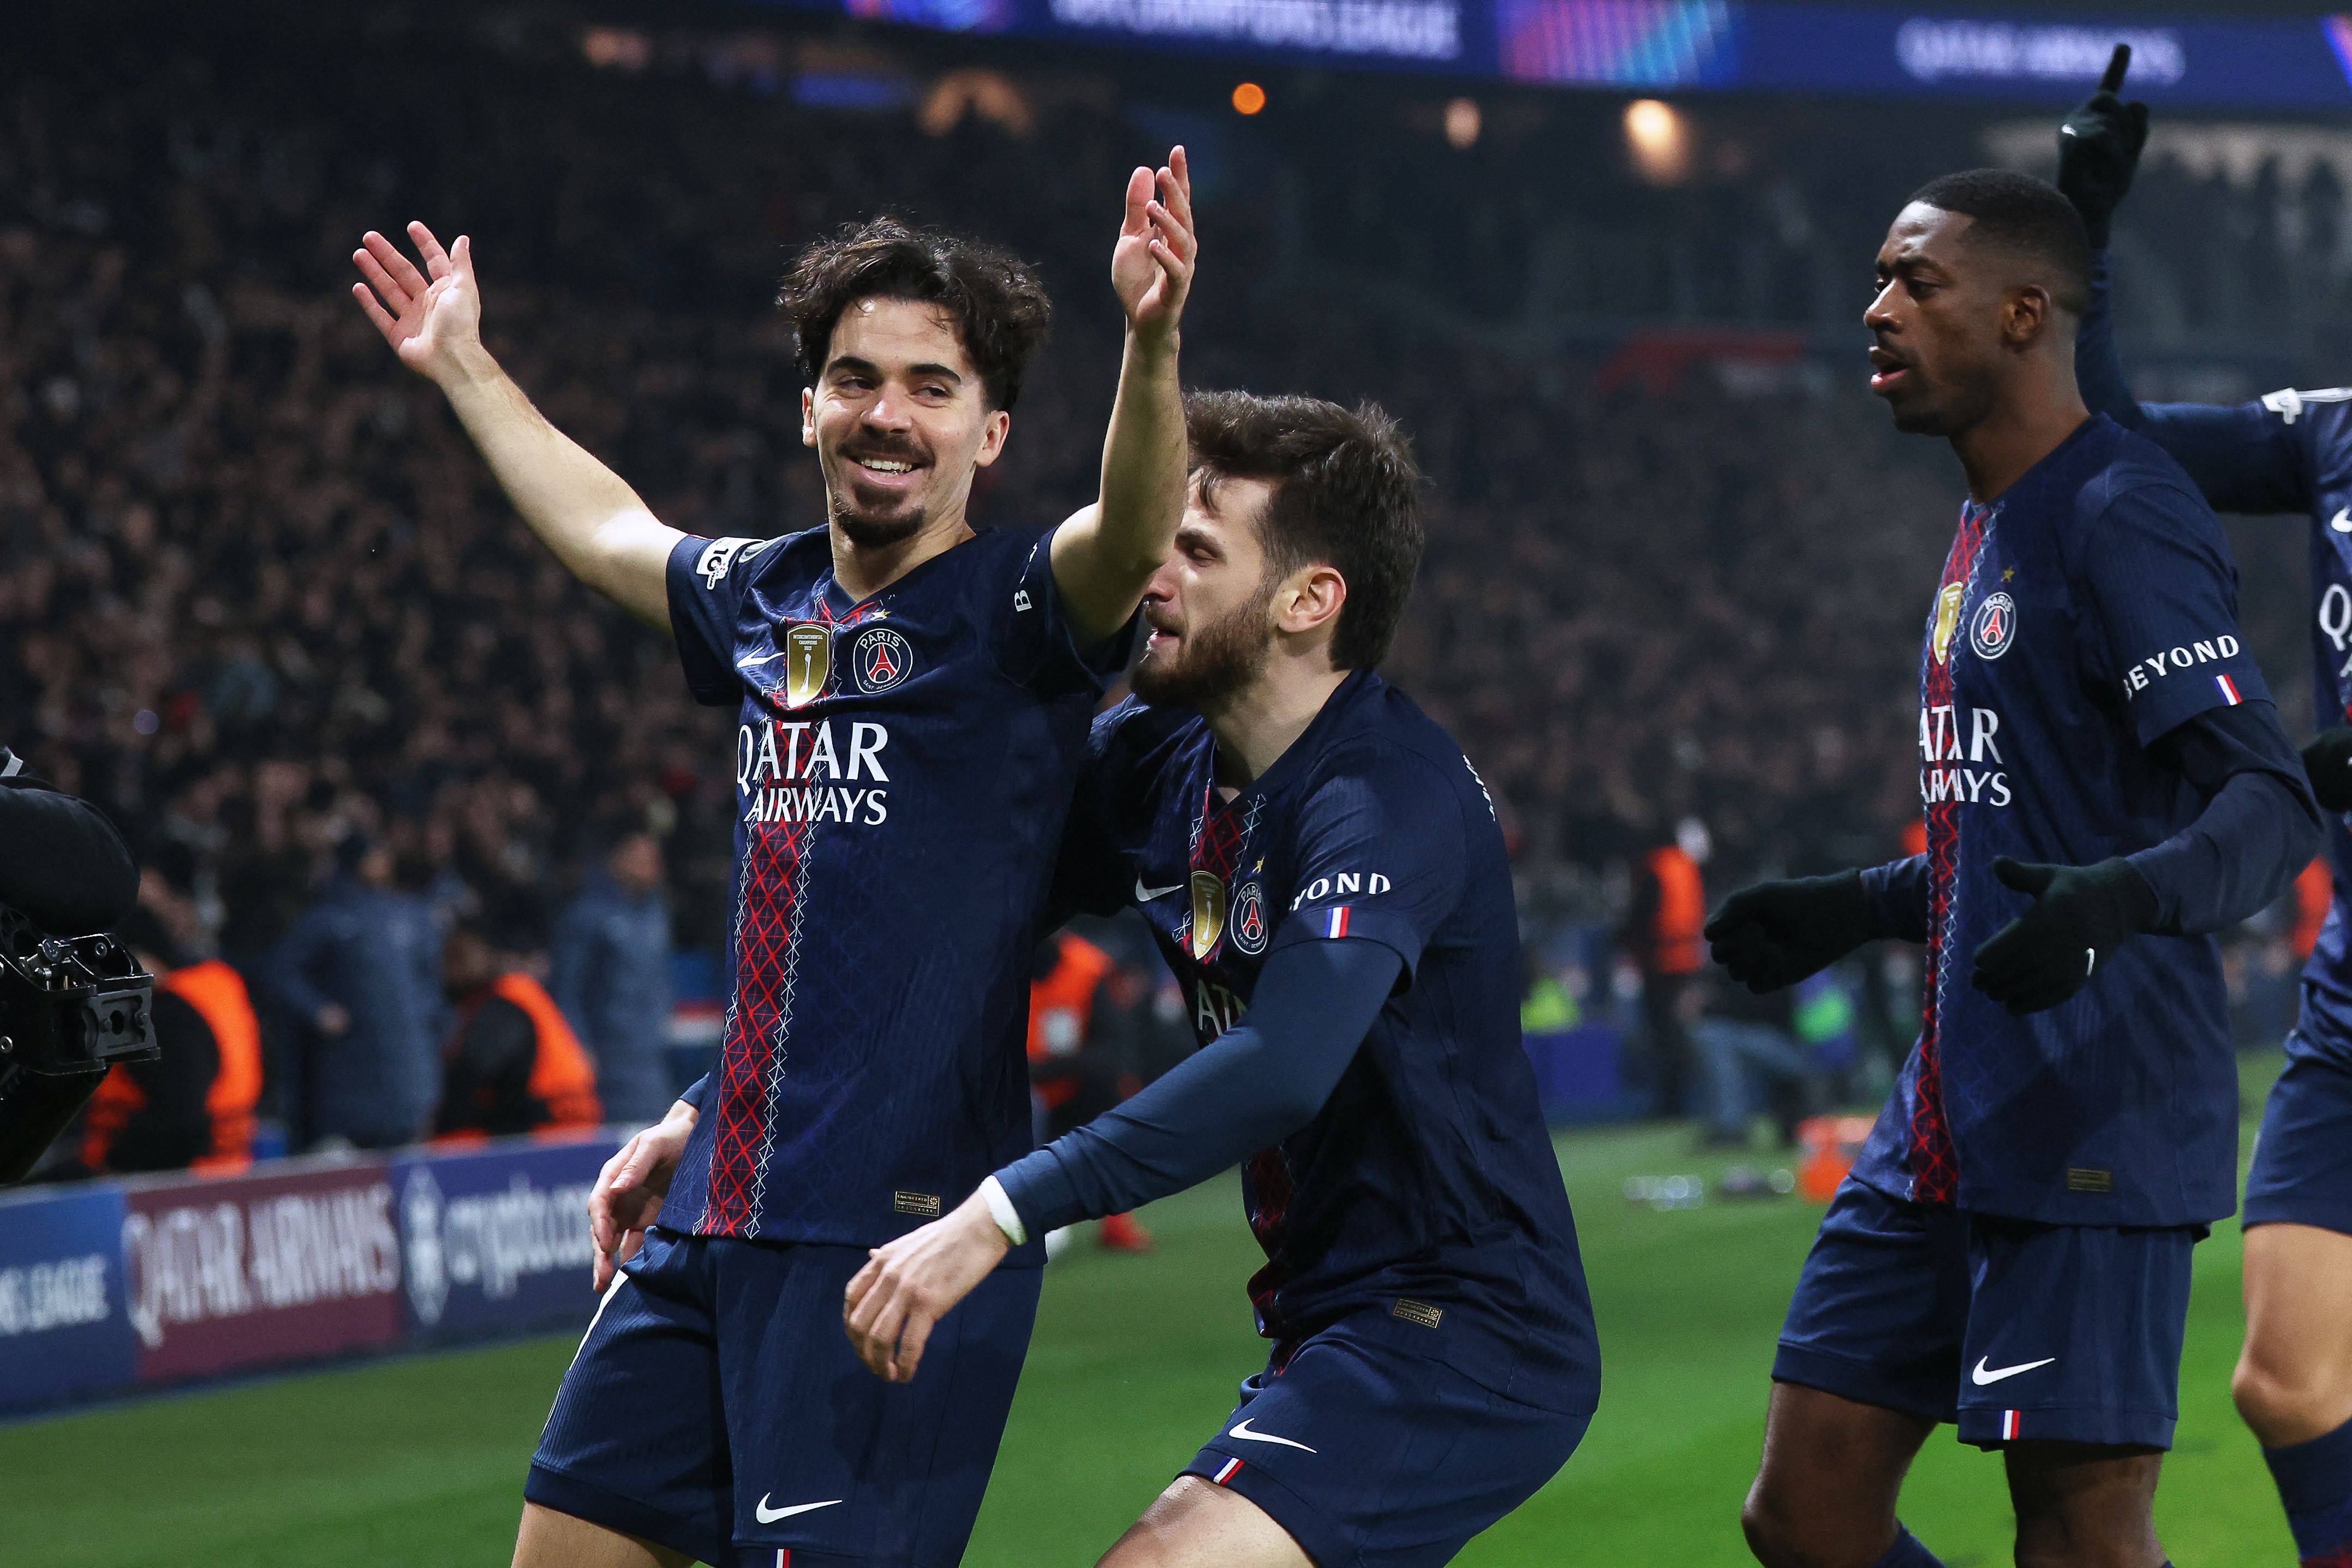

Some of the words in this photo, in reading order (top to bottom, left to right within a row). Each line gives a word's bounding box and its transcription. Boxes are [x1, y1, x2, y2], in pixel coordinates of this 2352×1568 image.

[860, 632, 900, 649] PARIS
[863, 680, 874, 690] SAINT
[1919, 704, 2003, 764] ATAR
[737, 720, 890, 797] QATAR
[743, 787, 887, 825] AIRWAYS
[1289, 872, 1391, 911] YOND
